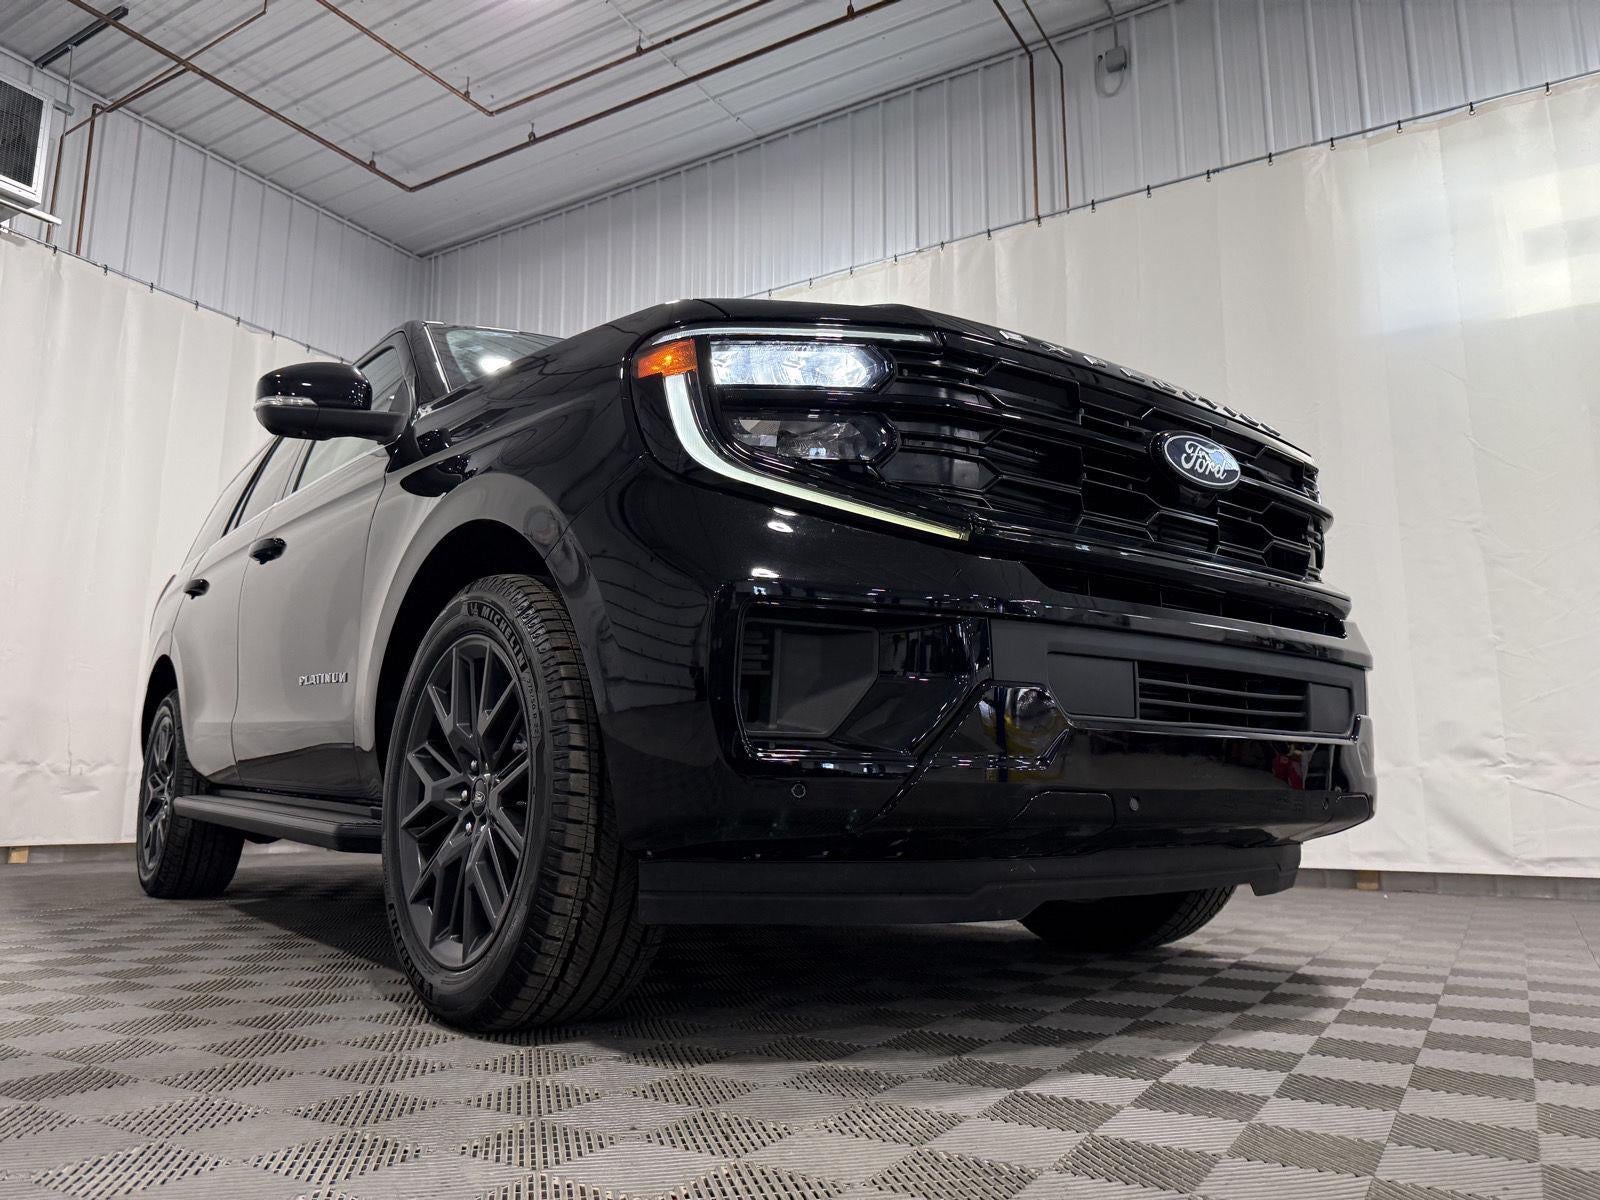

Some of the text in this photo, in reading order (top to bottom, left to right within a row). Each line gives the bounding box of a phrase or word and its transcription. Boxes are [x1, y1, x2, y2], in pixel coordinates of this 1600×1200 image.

[1181, 441, 1227, 480] Ford
[481, 605, 527, 667] MICHELIN
[299, 672, 348, 686] PLATINUM
